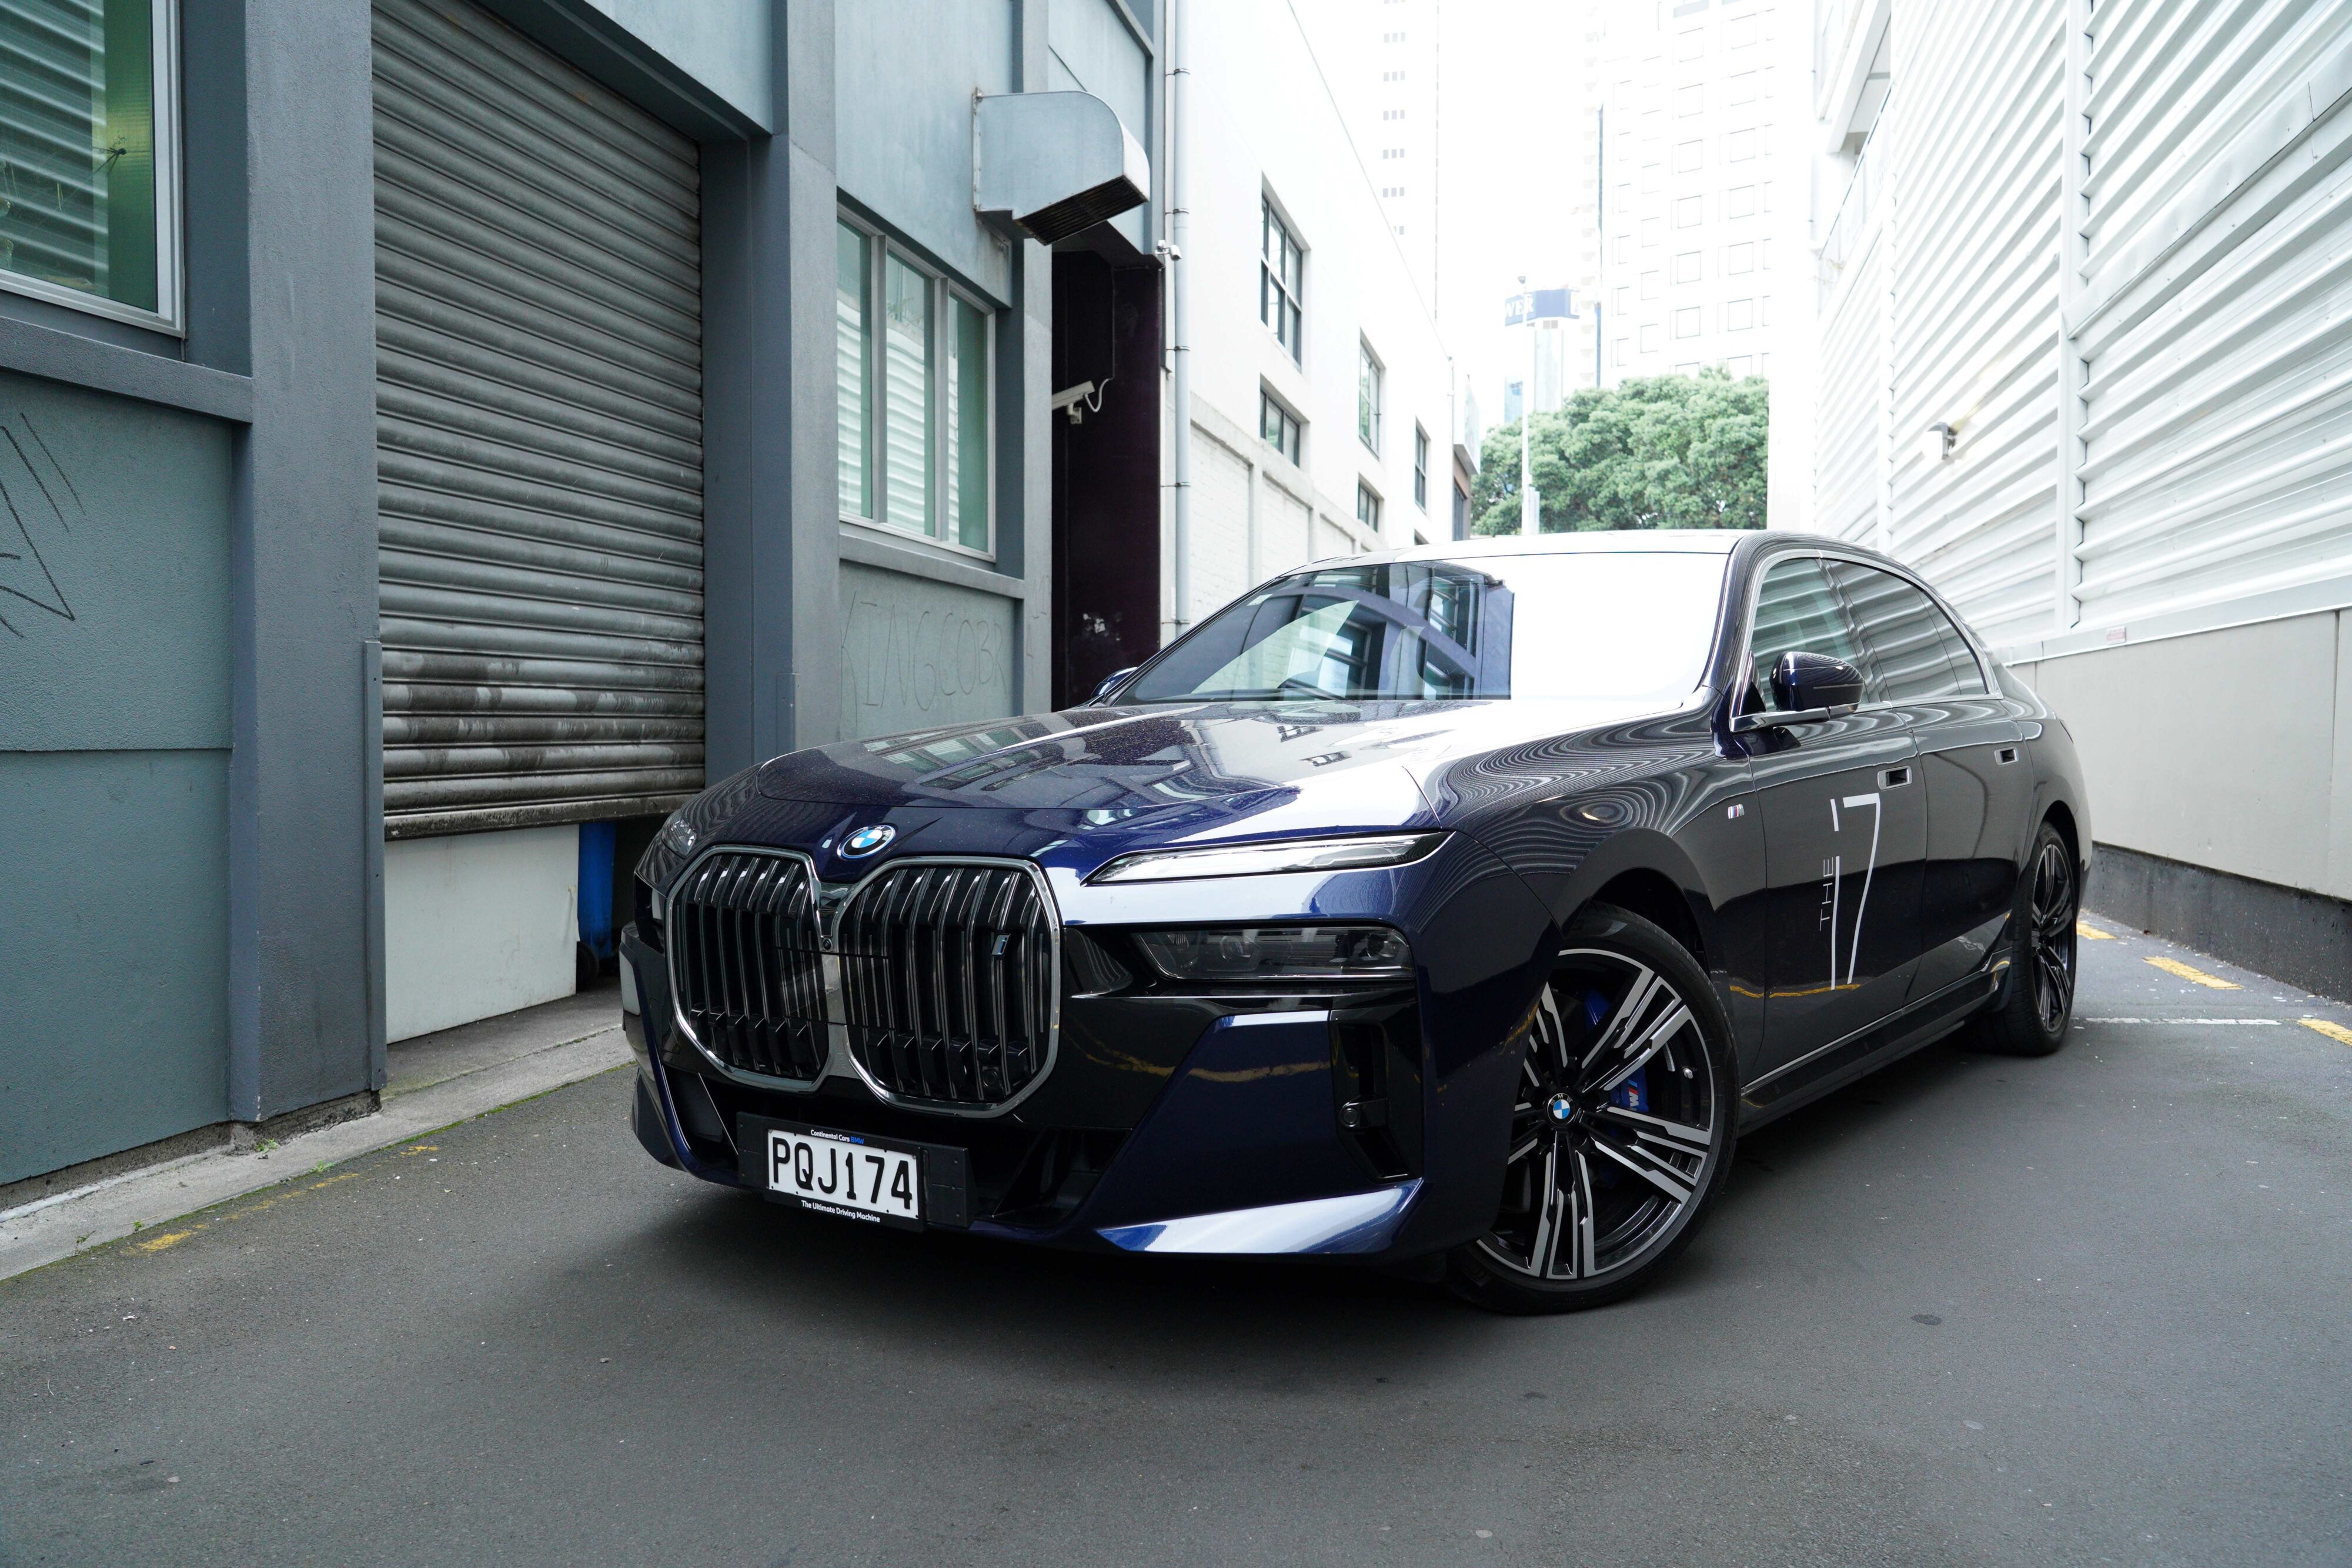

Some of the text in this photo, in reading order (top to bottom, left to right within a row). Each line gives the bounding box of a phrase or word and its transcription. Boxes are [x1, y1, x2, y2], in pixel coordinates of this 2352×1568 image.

[1819, 857, 1833, 931] THE
[1550, 1094, 1573, 1106] BMW
[810, 1129, 864, 1144] Continental Cars BMW
[772, 1136, 913, 1209] PQJ174
[801, 1199, 880, 1223] The Ultimate Driving Machine
